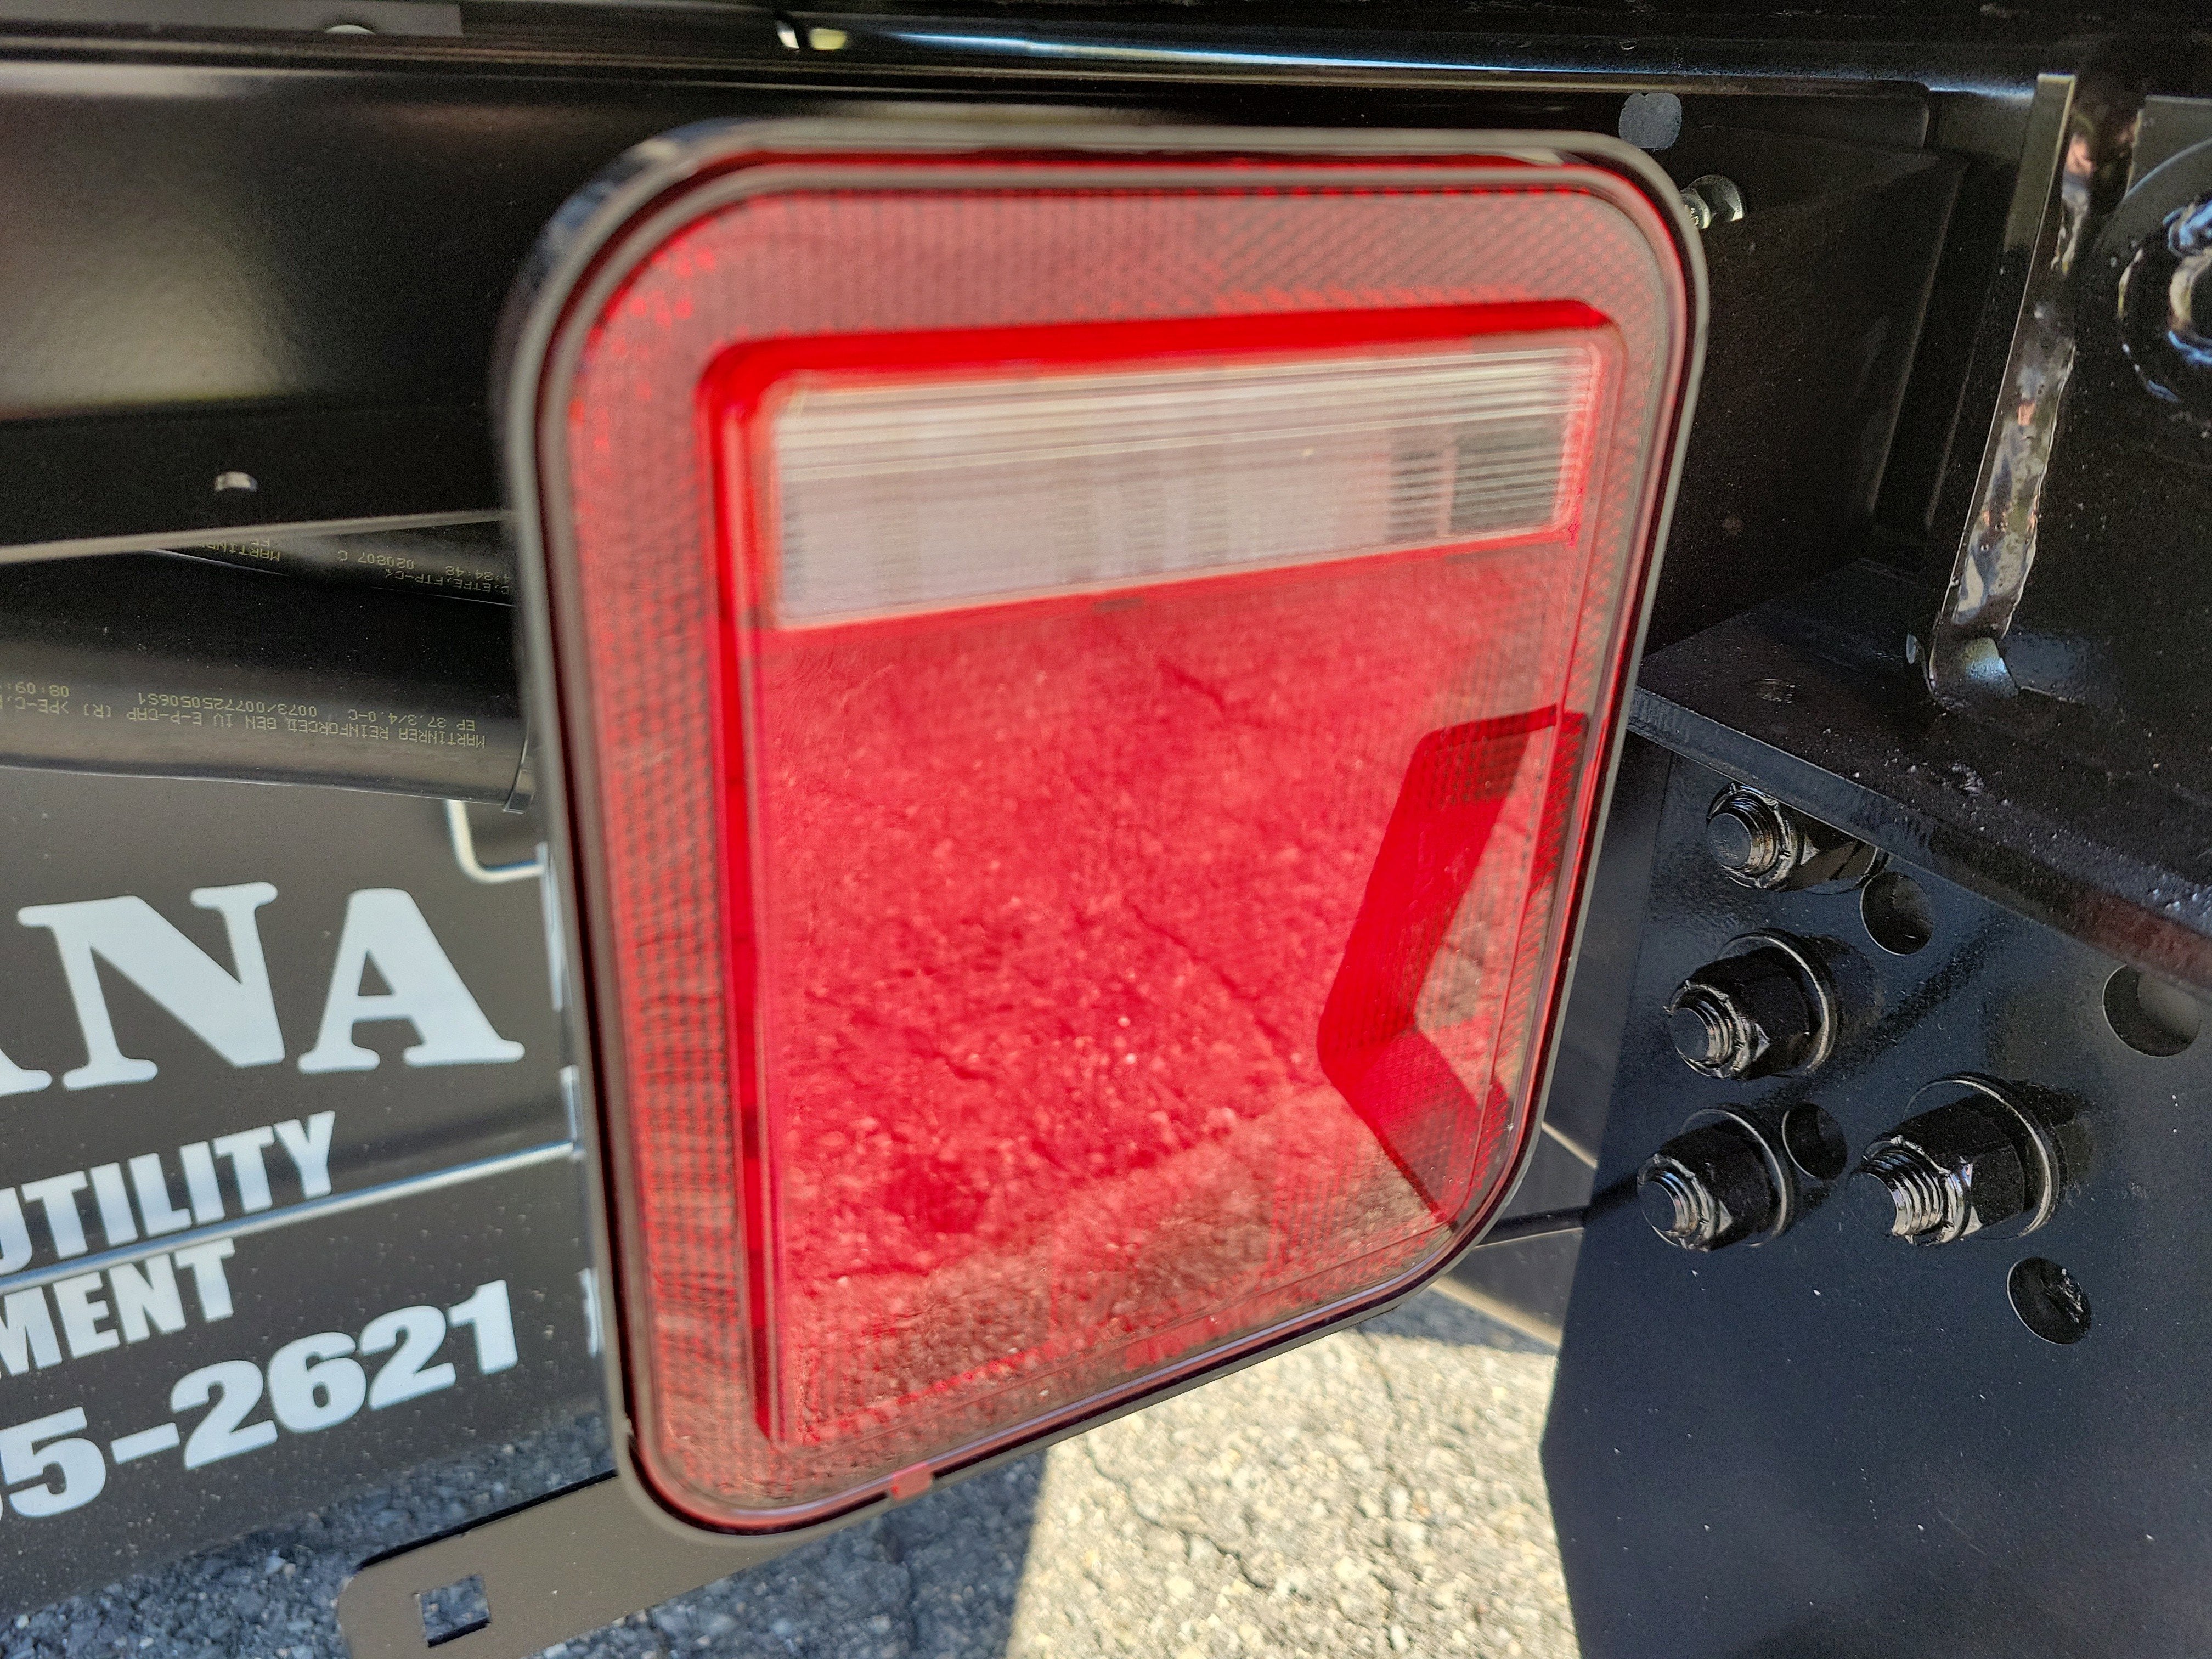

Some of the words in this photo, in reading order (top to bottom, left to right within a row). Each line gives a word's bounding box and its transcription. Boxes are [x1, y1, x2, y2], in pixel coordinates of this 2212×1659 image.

[357, 552, 415, 570] 020807
[0, 681, 70, 698] 08:09:
[126, 707, 202, 727] E-P-CAP
[245, 715, 277, 731] GEN
[456, 718, 476, 731] EP
[399, 727, 485, 749] MARTINREA
[0, 1280, 518, 1519] 5-2621
